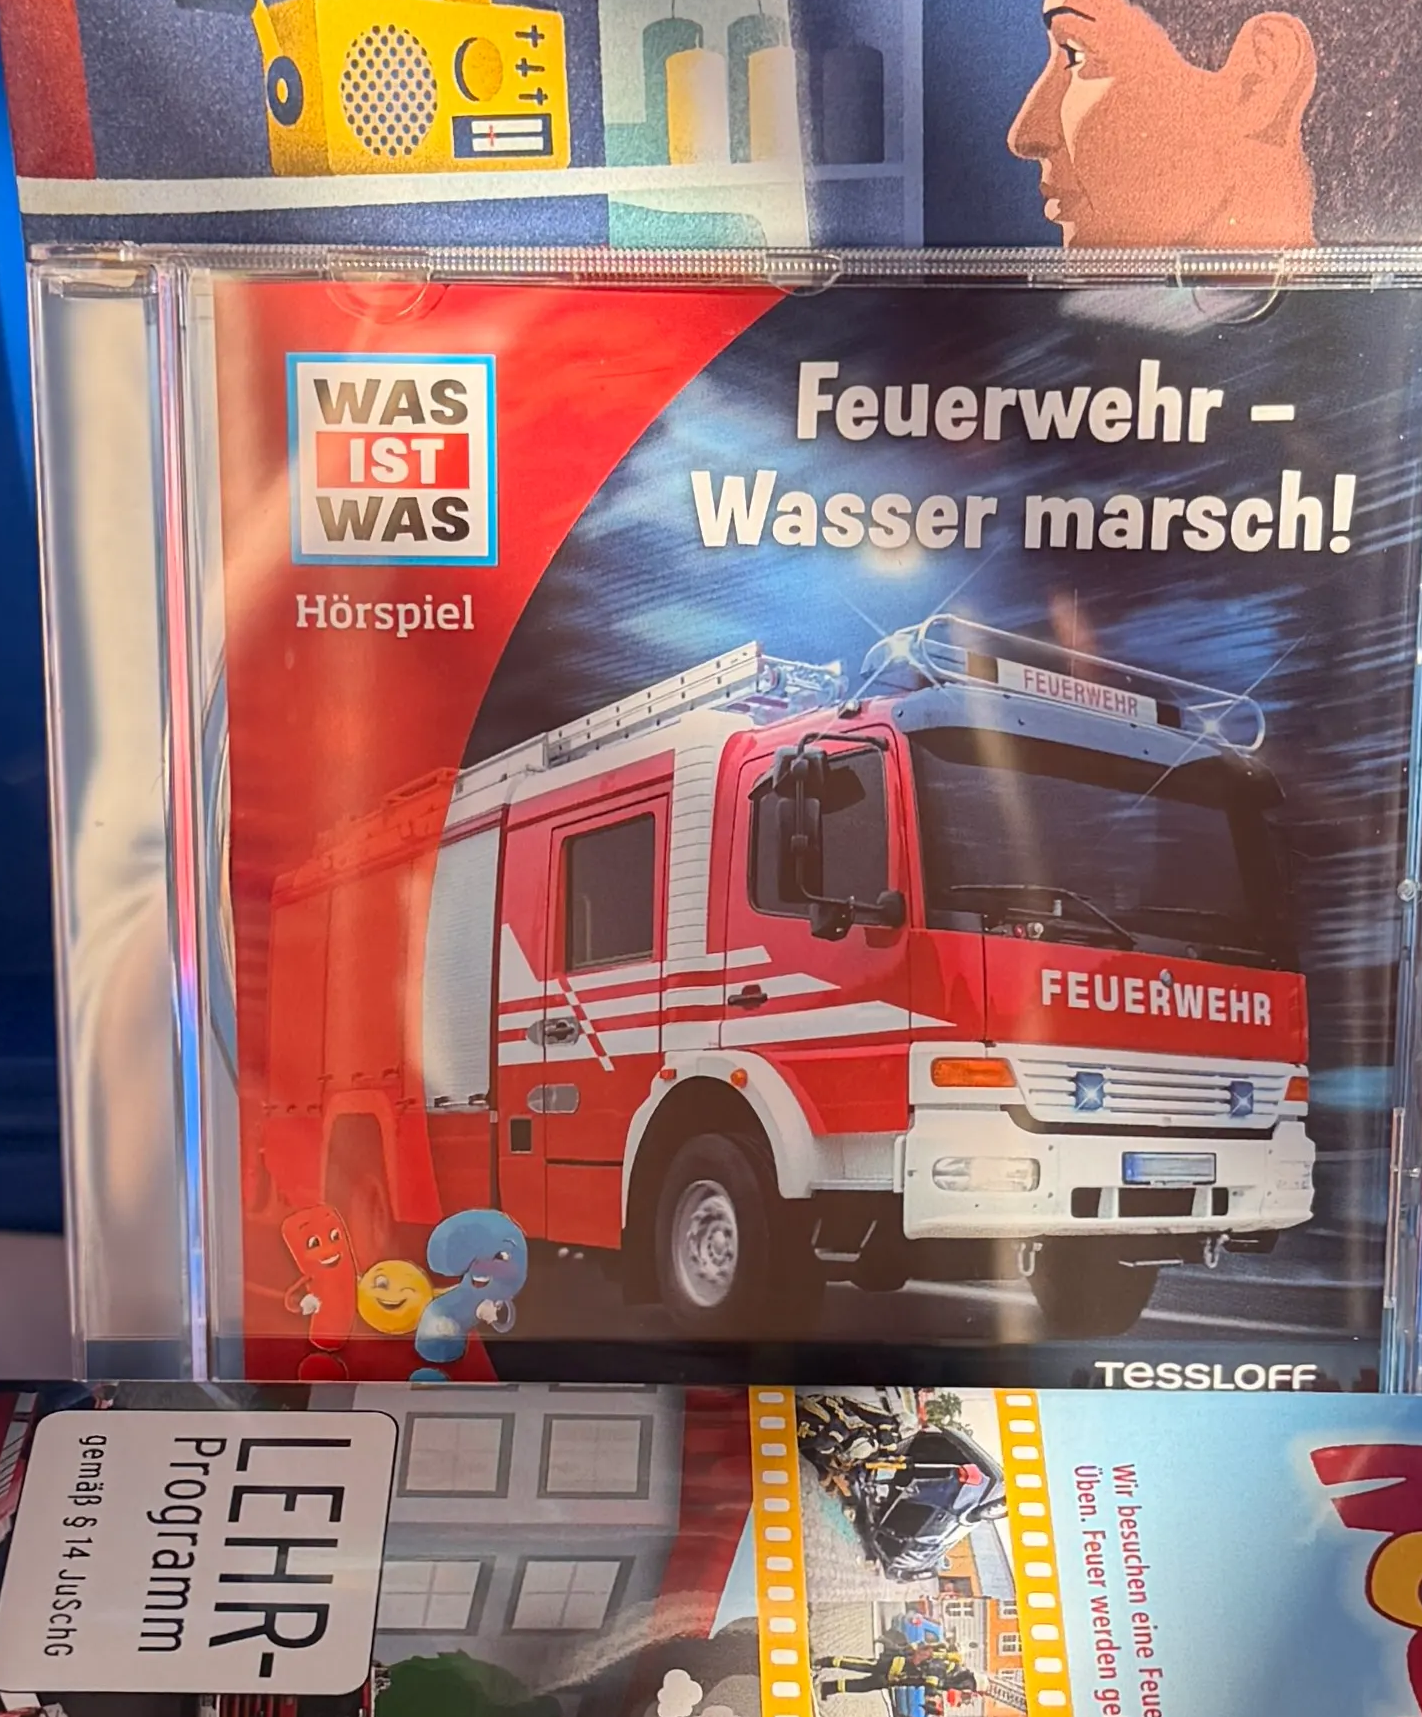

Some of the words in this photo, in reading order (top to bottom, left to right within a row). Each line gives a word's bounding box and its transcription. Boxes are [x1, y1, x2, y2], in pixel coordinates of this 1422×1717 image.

[313, 378, 469, 427] WAS
[796, 358, 1224, 444] Feuerwehr
[347, 436, 446, 485] IST
[314, 495, 473, 545] WAS
[690, 469, 999, 550] Wasser
[1024, 470, 1357, 554] marsch!
[295, 592, 475, 639] Hörspiel
[1022, 668, 1139, 718] FEUERWEHR
[1041, 968, 1272, 1027] FEUERWEHR
[67, 1434, 108, 1506] gemäß
[1073, 1464, 1104, 1523] Üben.
[1111, 1463, 1139, 1498] Wir
[62, 1536, 94, 1560] 14
[137, 1437, 228, 1653] Programm
[207, 1437, 352, 1678] LEHR-
[1081, 1529, 1107, 1588] Feuer
[1117, 1505, 1151, 1604] besuchen
[43, 1568, 87, 1657] JuSchG
[1090, 1595, 1122, 1679] werden
[1131, 1612, 1159, 1659] eine
